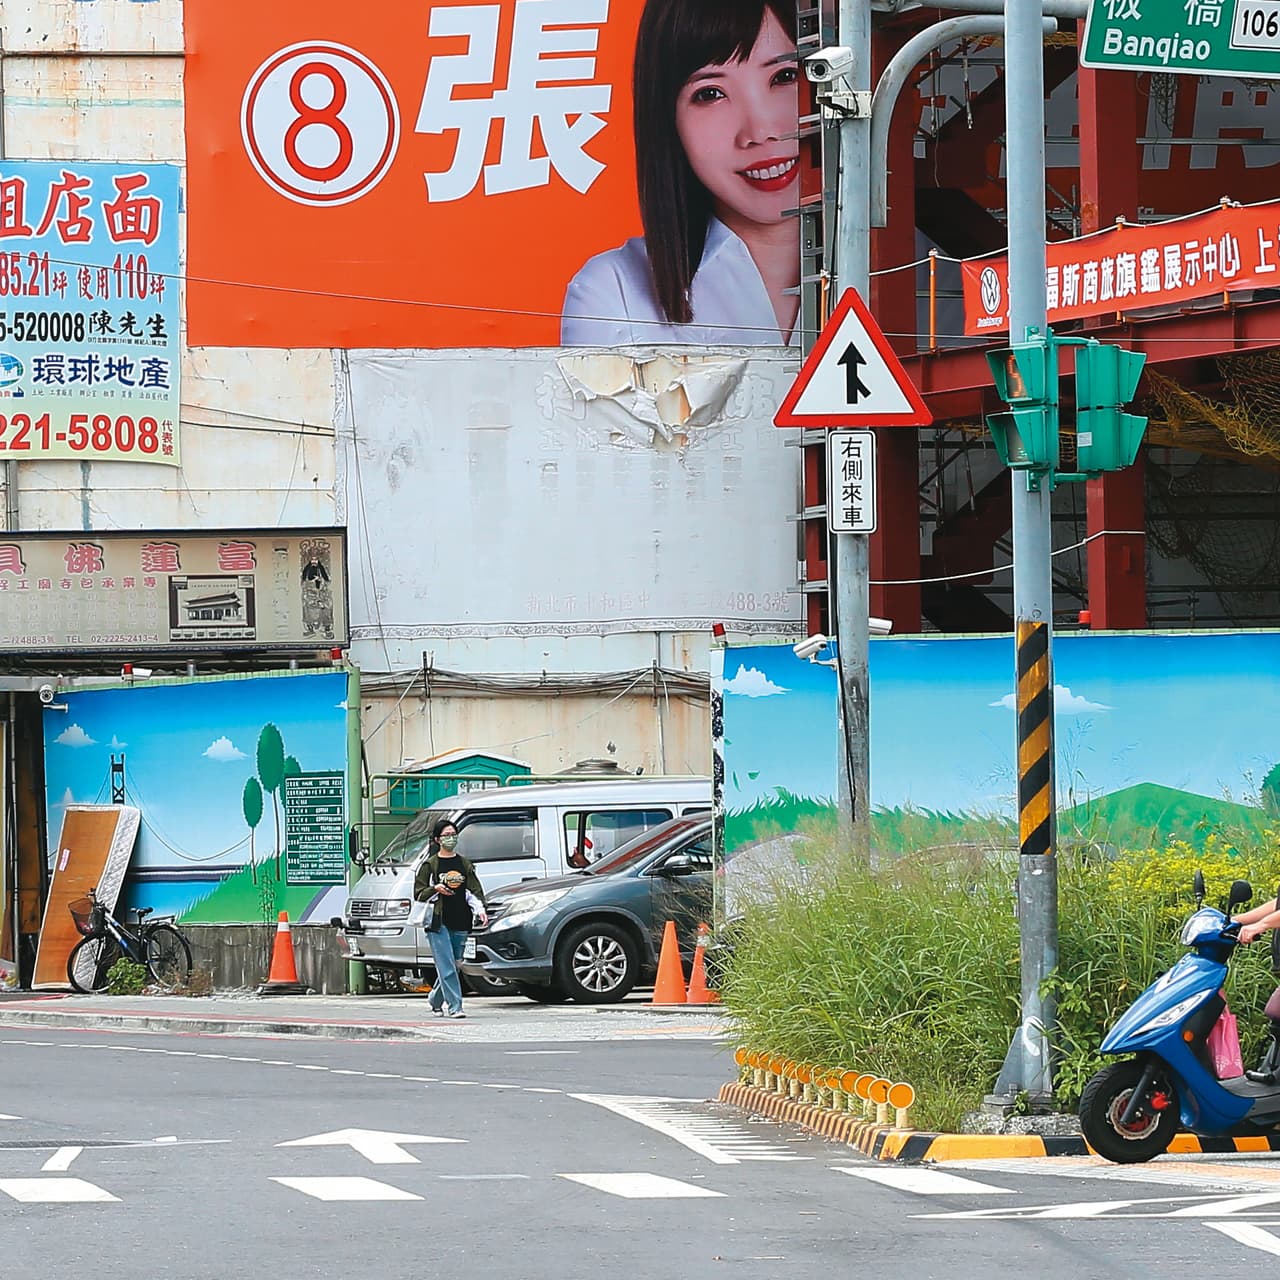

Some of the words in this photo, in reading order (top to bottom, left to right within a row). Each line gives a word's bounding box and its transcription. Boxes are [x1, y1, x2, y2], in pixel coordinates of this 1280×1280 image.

[1103, 28, 1211, 64] Banqiao
[1241, 9, 1280, 38] 106
[282, 61, 355, 183] 8
[88, 310, 168, 339] 陳先生
[32, 353, 170, 389] 環球地產
[162, 419, 174, 456] 代表號
[839, 436, 864, 528] 右側來車
[66, 635, 83, 644] TEL
